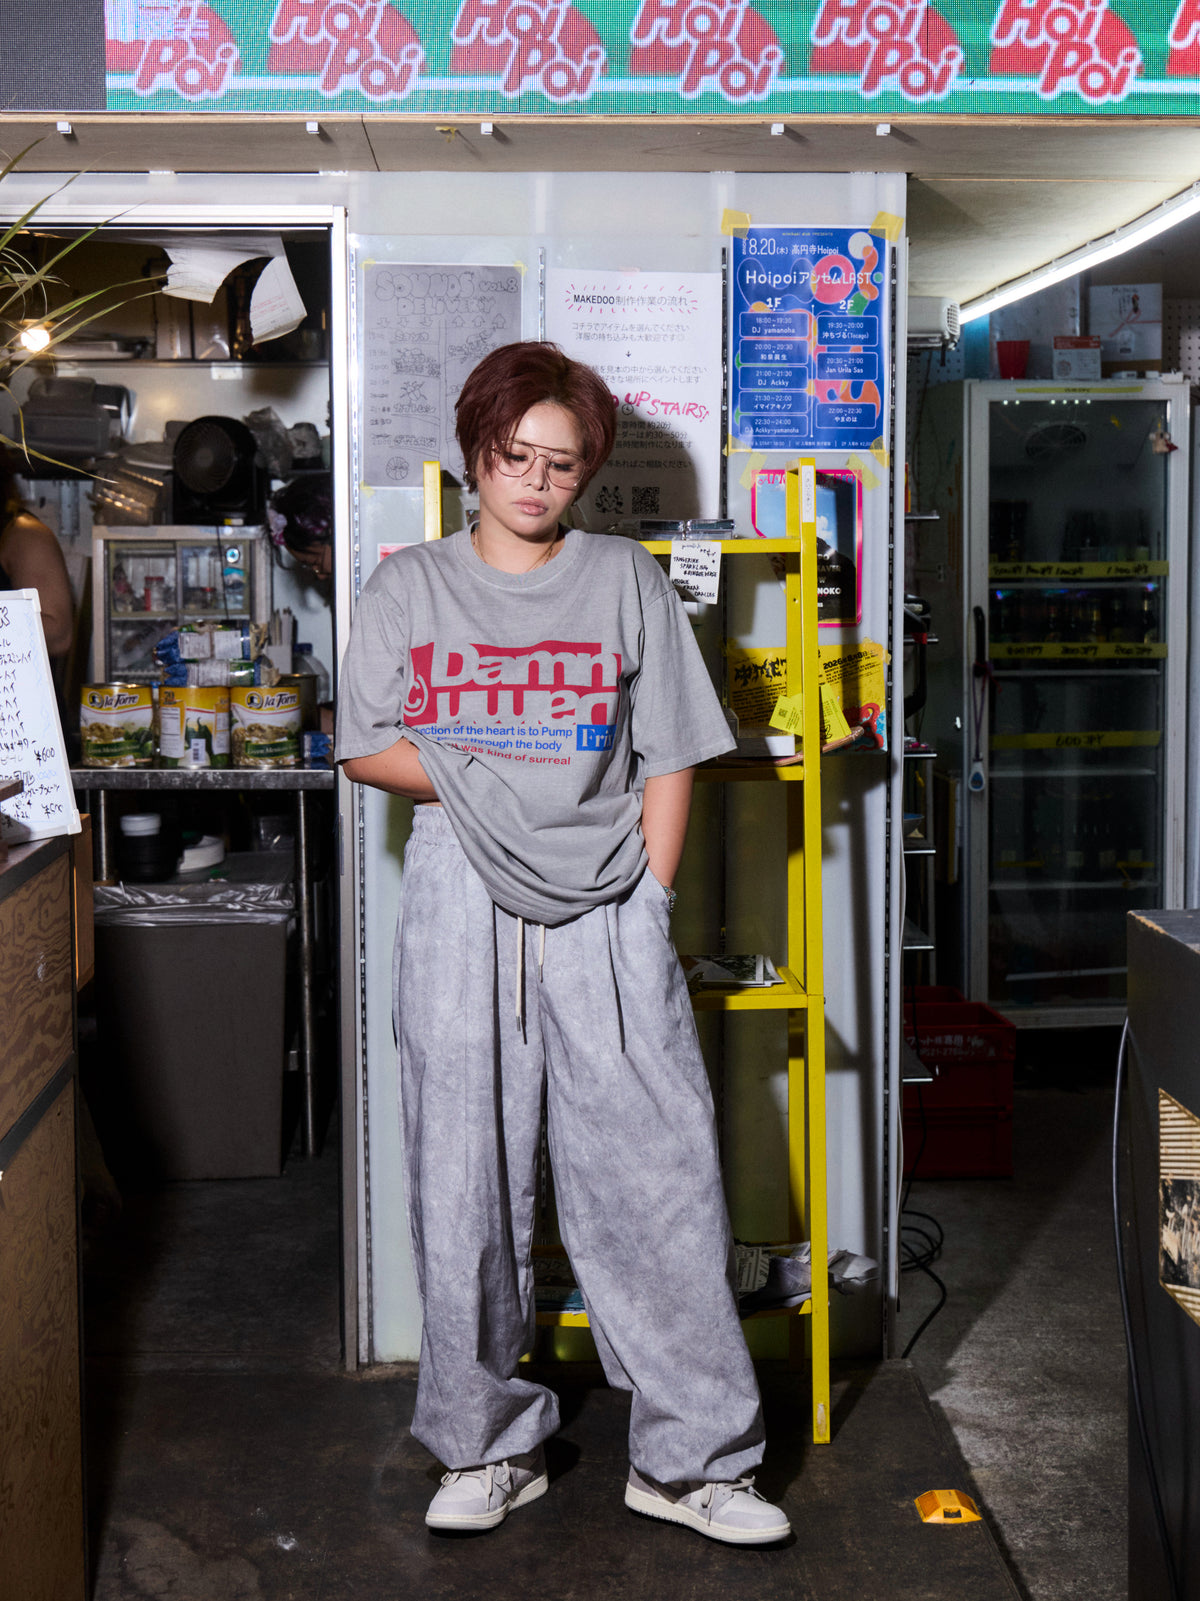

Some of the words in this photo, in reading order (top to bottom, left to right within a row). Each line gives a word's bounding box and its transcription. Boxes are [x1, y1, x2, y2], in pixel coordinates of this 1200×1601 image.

[135, 39, 238, 96] Poi
[320, 38, 426, 99] Poi
[500, 38, 607, 101] Poi
[681, 40, 783, 101] Poi
[860, 40, 965, 101] Poi
[1037, 40, 1142, 102] Poi
[766, 298, 782, 308] 1F
[839, 300, 854, 310] 2F
[453, 726, 464, 735] of
[466, 726, 483, 735] the
[486, 726, 515, 736] heart
[517, 726, 526, 736] is
[528, 727, 539, 736] to
[541, 727, 573, 739] Pump
[460, 745, 484, 754] was
[487, 748, 511, 759] kind
[529, 755, 571, 765] surreal
[470, 738, 513, 749] through
[515, 740, 533, 749] the
[535, 741, 562, 752] body
